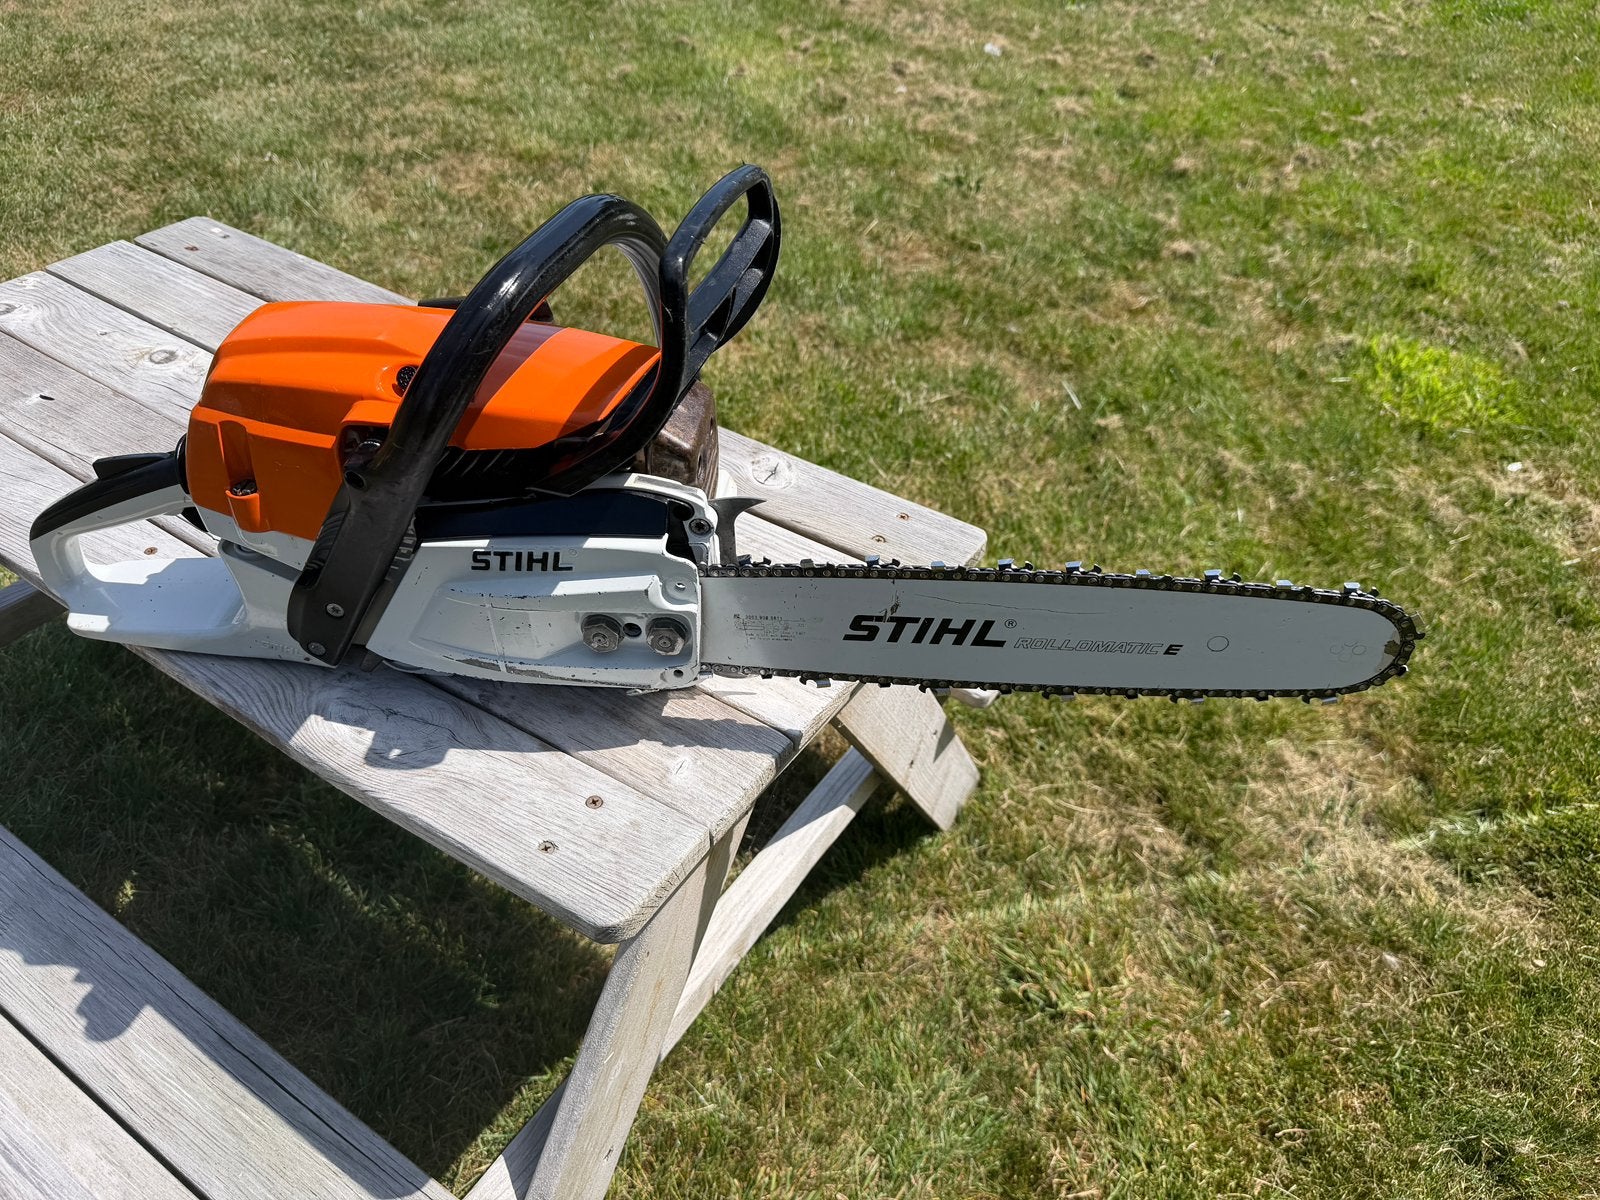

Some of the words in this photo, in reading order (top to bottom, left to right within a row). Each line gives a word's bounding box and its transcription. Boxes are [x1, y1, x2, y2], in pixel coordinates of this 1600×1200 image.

[471, 551, 573, 571] STIHL
[842, 614, 1007, 648] STIHL
[1013, 637, 1163, 655] ROLLOMATIC
[1162, 644, 1184, 656] E
